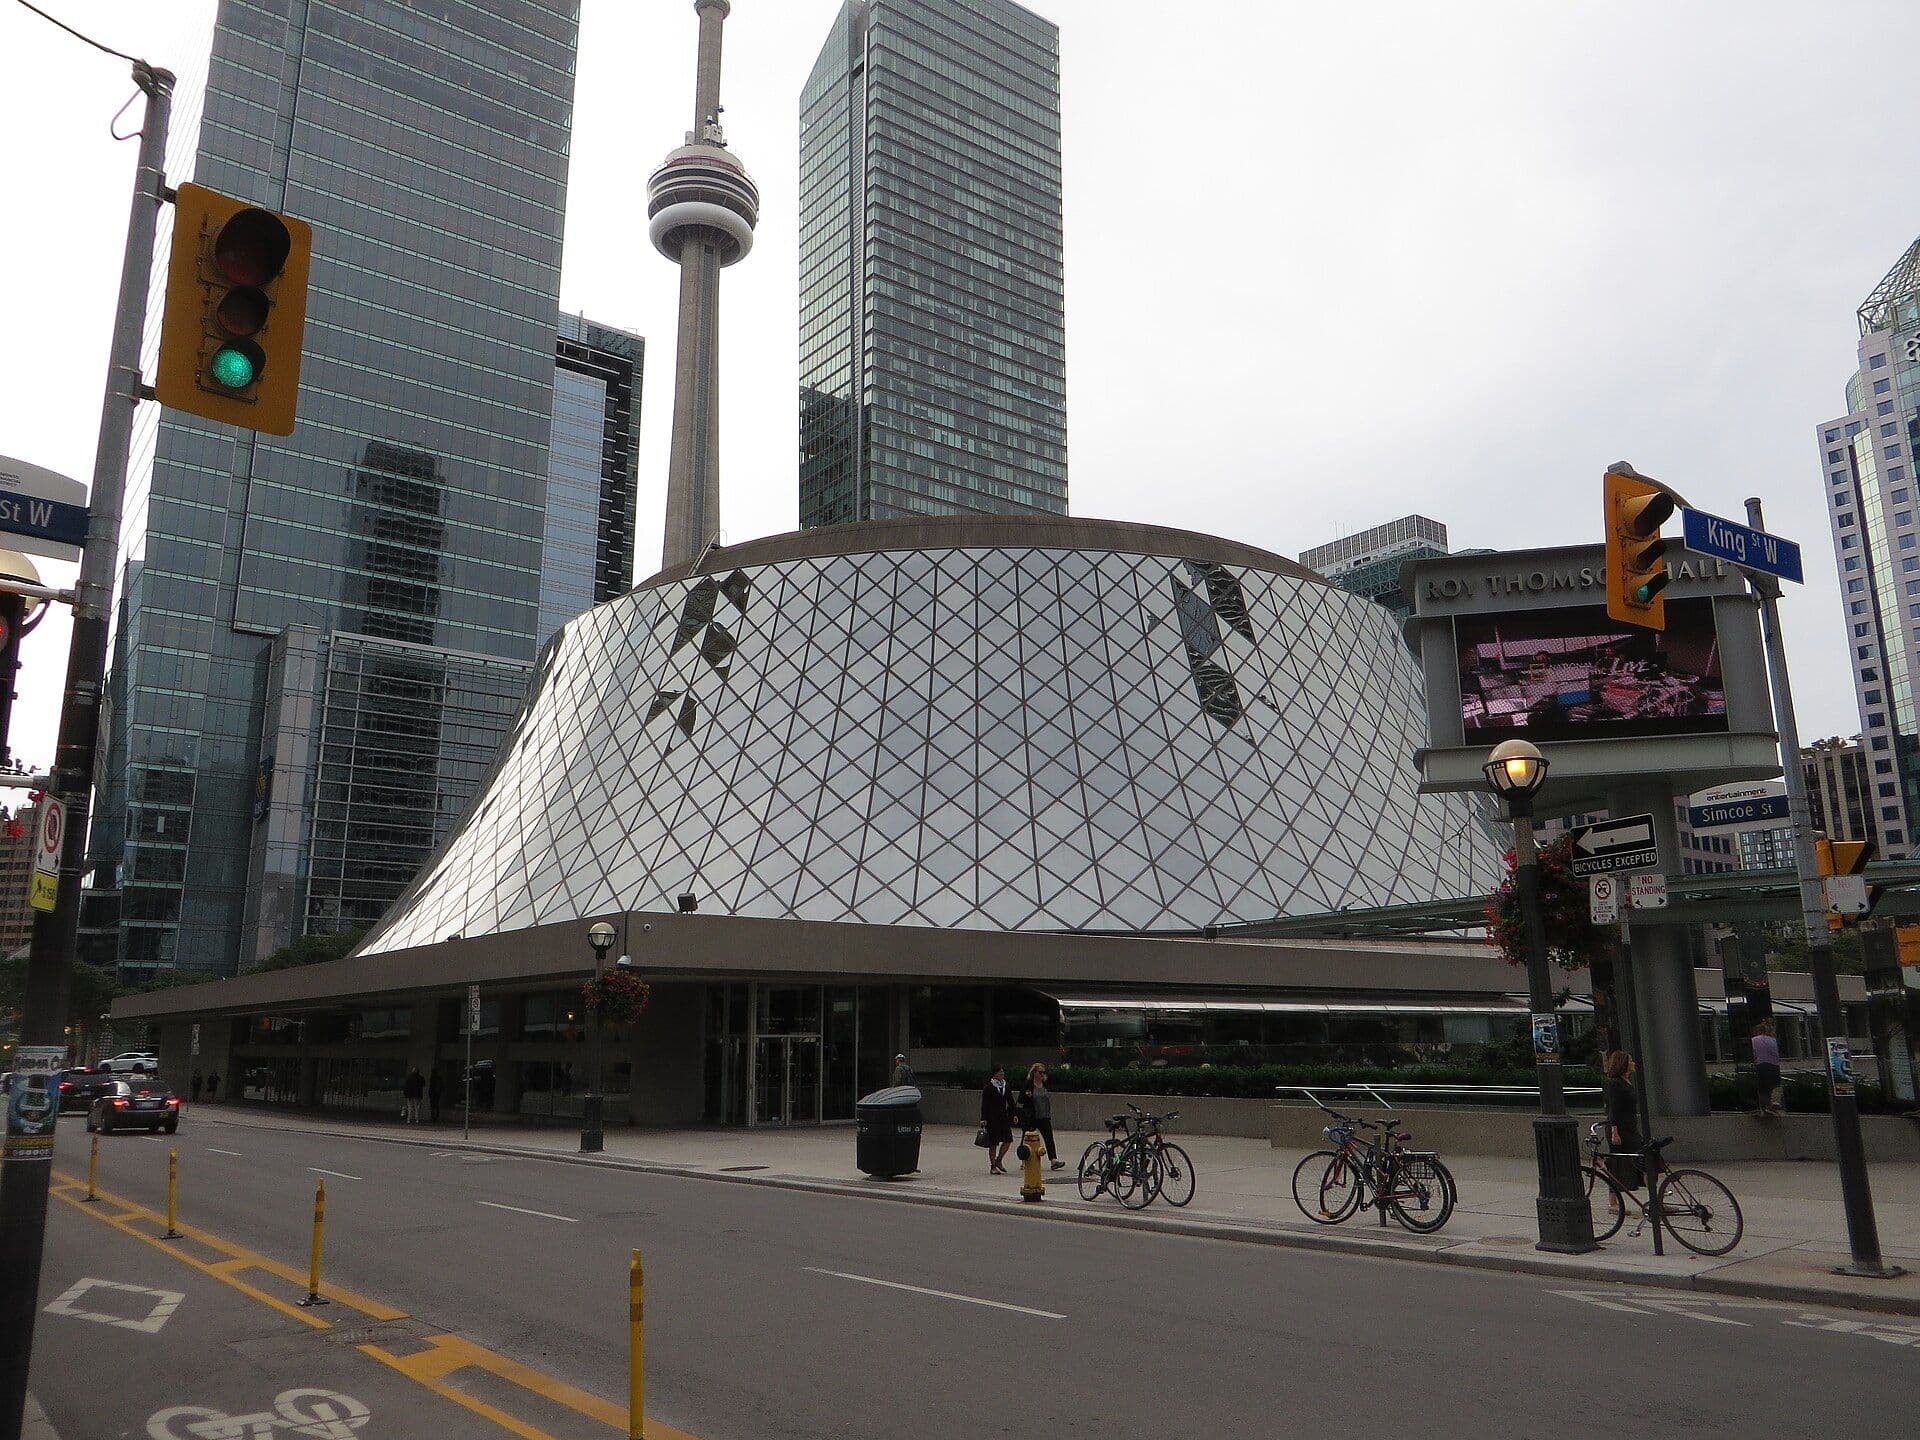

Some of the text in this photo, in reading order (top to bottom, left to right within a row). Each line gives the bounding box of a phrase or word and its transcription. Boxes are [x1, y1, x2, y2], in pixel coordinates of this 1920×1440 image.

[0, 500, 53, 527] St W
[1707, 518, 1778, 564] King St W
[1706, 788, 1767, 802] entertainment
[1702, 803, 1774, 822] Simcoe St
[1574, 852, 1657, 873] BICYCLES EXCEPTED
[1641, 875, 1653, 884] NO
[1631, 885, 1665, 896] STANDING
